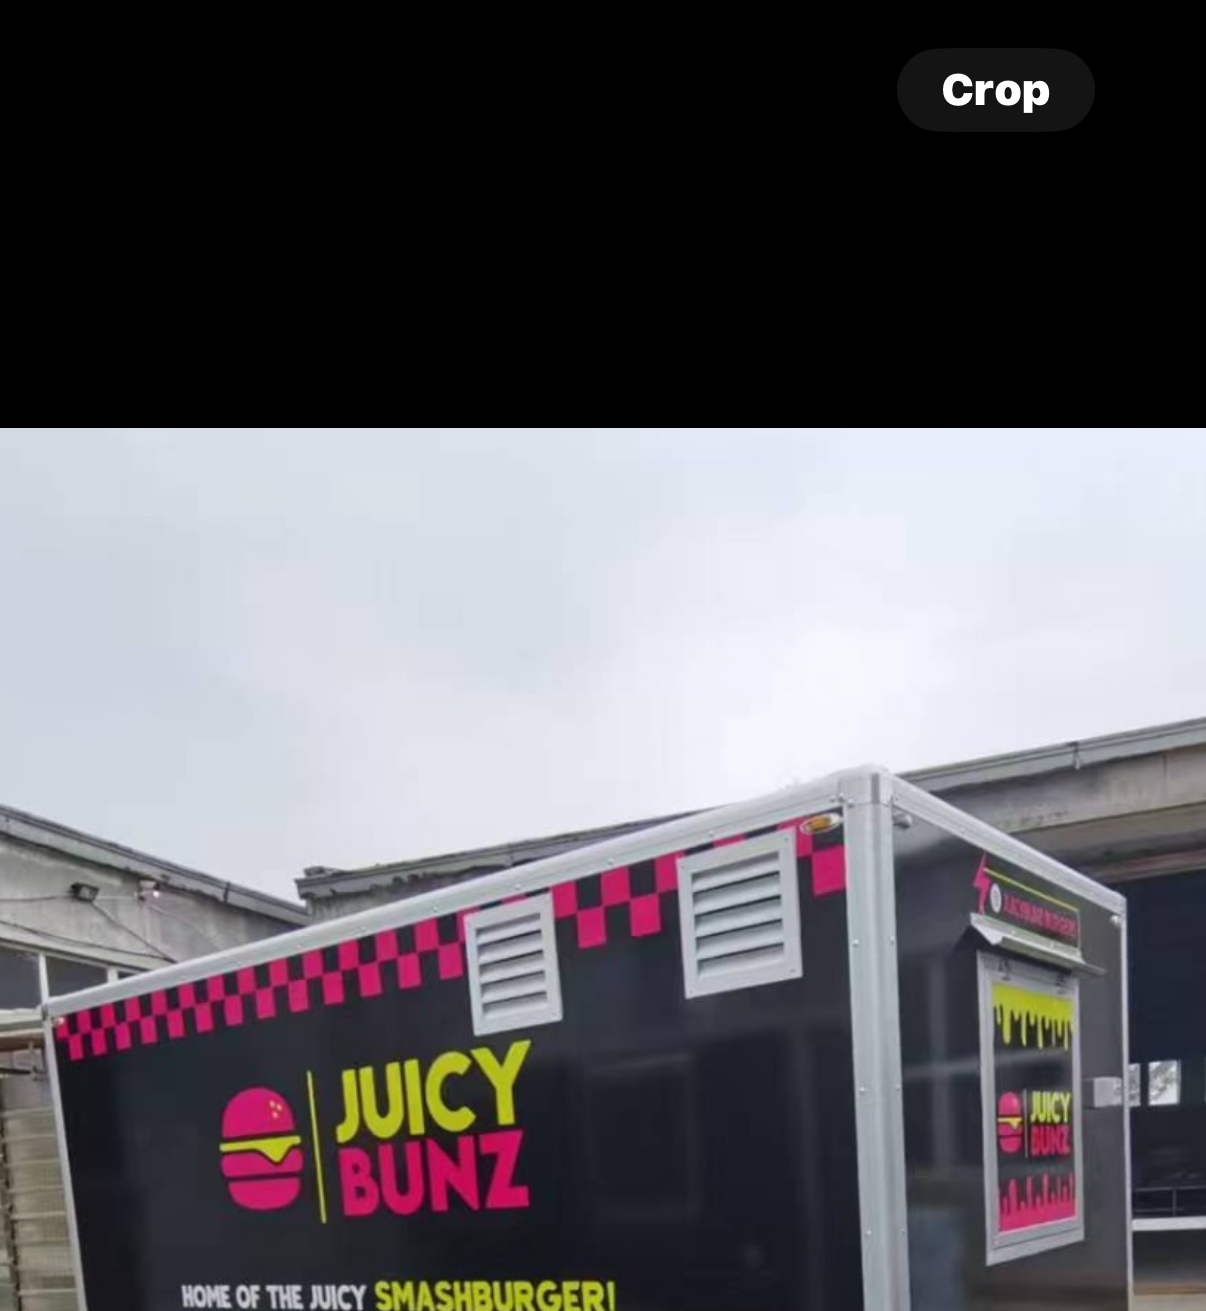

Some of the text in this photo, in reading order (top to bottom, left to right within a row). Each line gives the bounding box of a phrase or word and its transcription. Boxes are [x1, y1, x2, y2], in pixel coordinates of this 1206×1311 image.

[336, 1040, 531, 1143] JUICY
[1030, 1090, 1071, 1123] JUICY
[1030, 1124, 1071, 1156] BUNZ
[338, 1129, 530, 1217] BUNZ
[181, 1284, 232, 1309] HOME
[235, 1284, 261, 1310] OF
[265, 1284, 304, 1310] THE
[309, 1284, 367, 1311] JUICY
